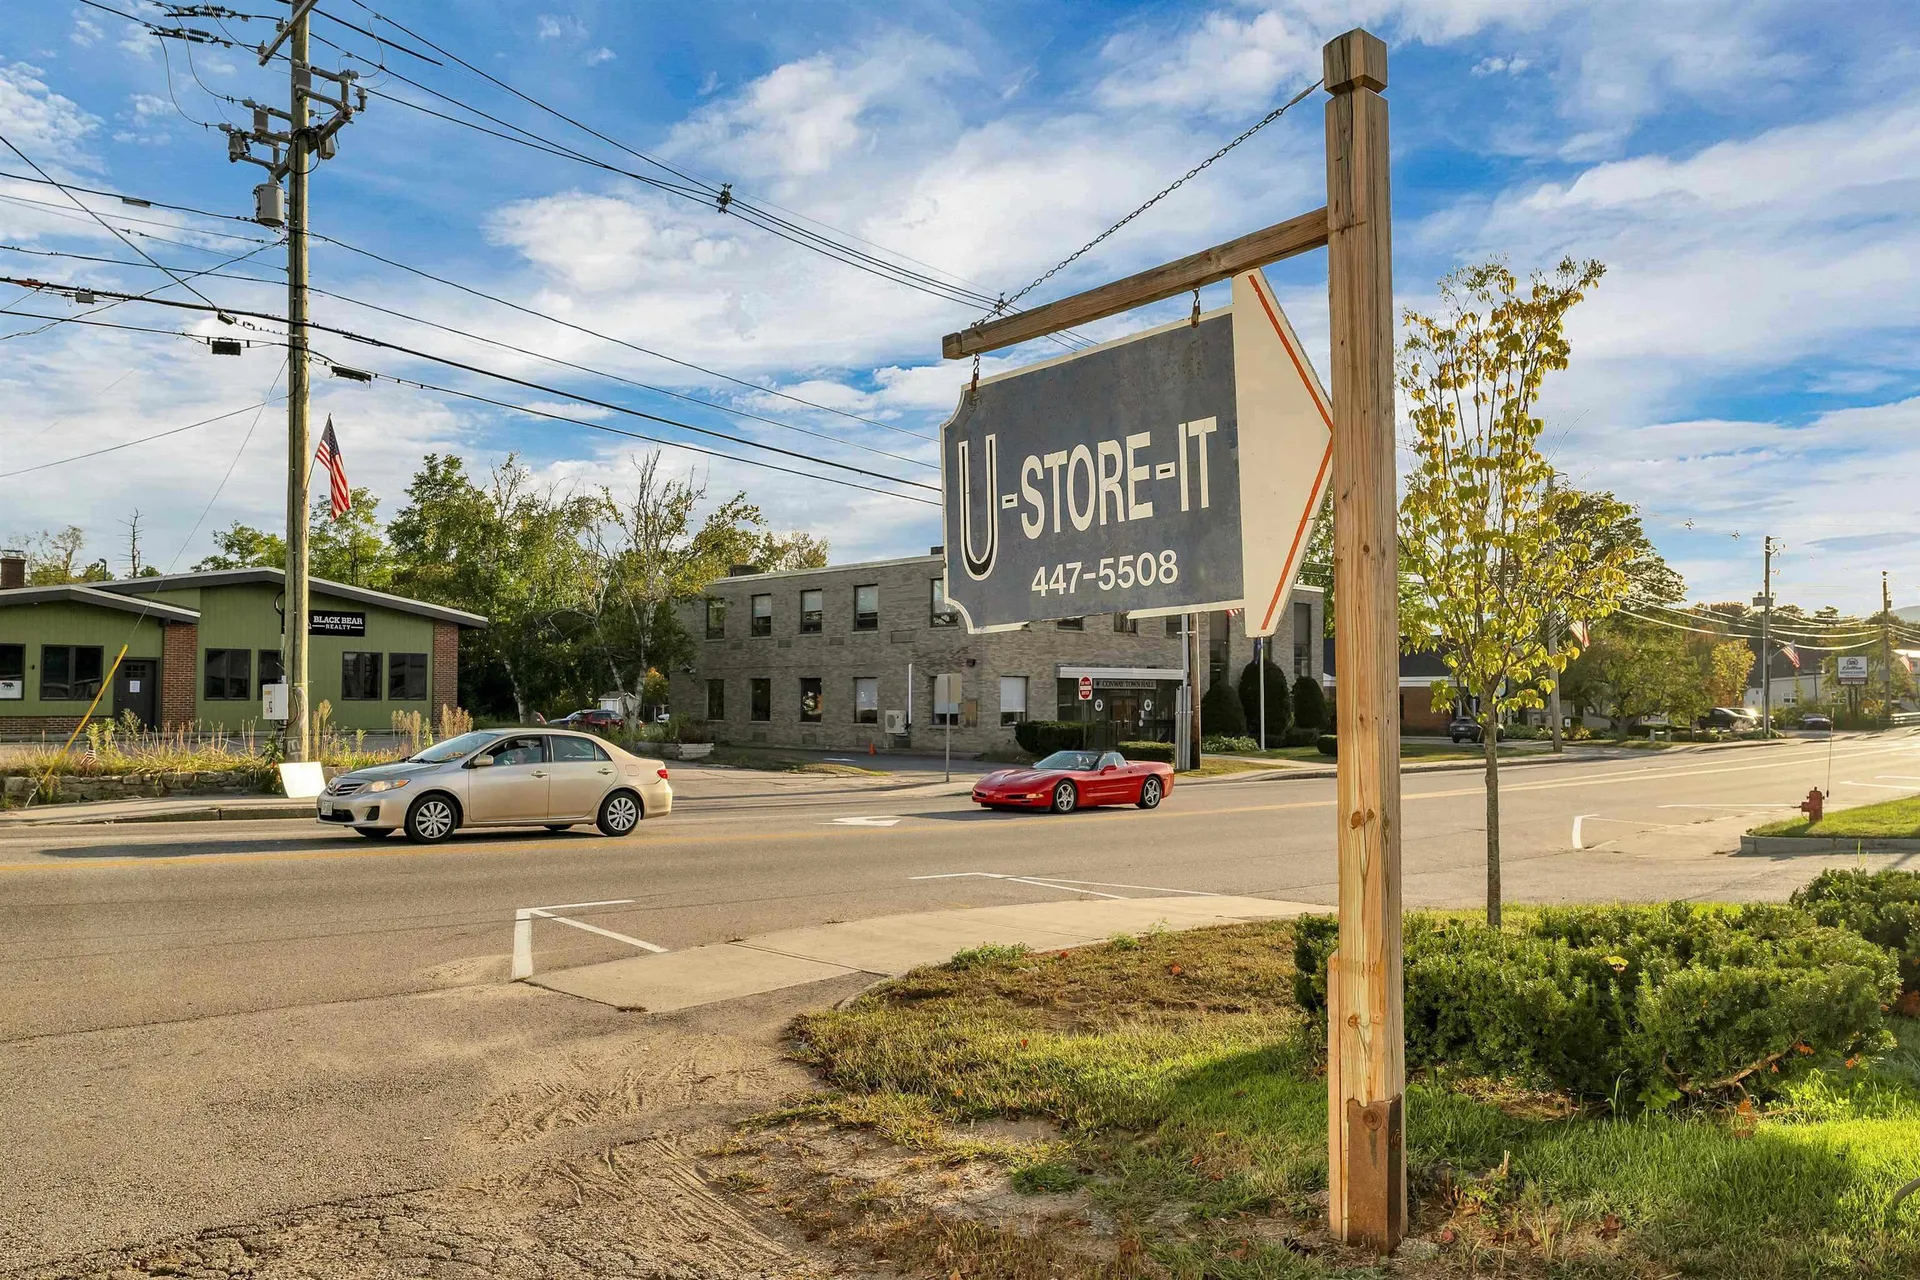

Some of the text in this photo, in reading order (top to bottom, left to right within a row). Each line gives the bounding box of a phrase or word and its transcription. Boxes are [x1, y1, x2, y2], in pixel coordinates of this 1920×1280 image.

[958, 415, 1217, 581] U-STORE-IT
[1031, 549, 1179, 597] 447-5508
[313, 616, 340, 624] BLACK
